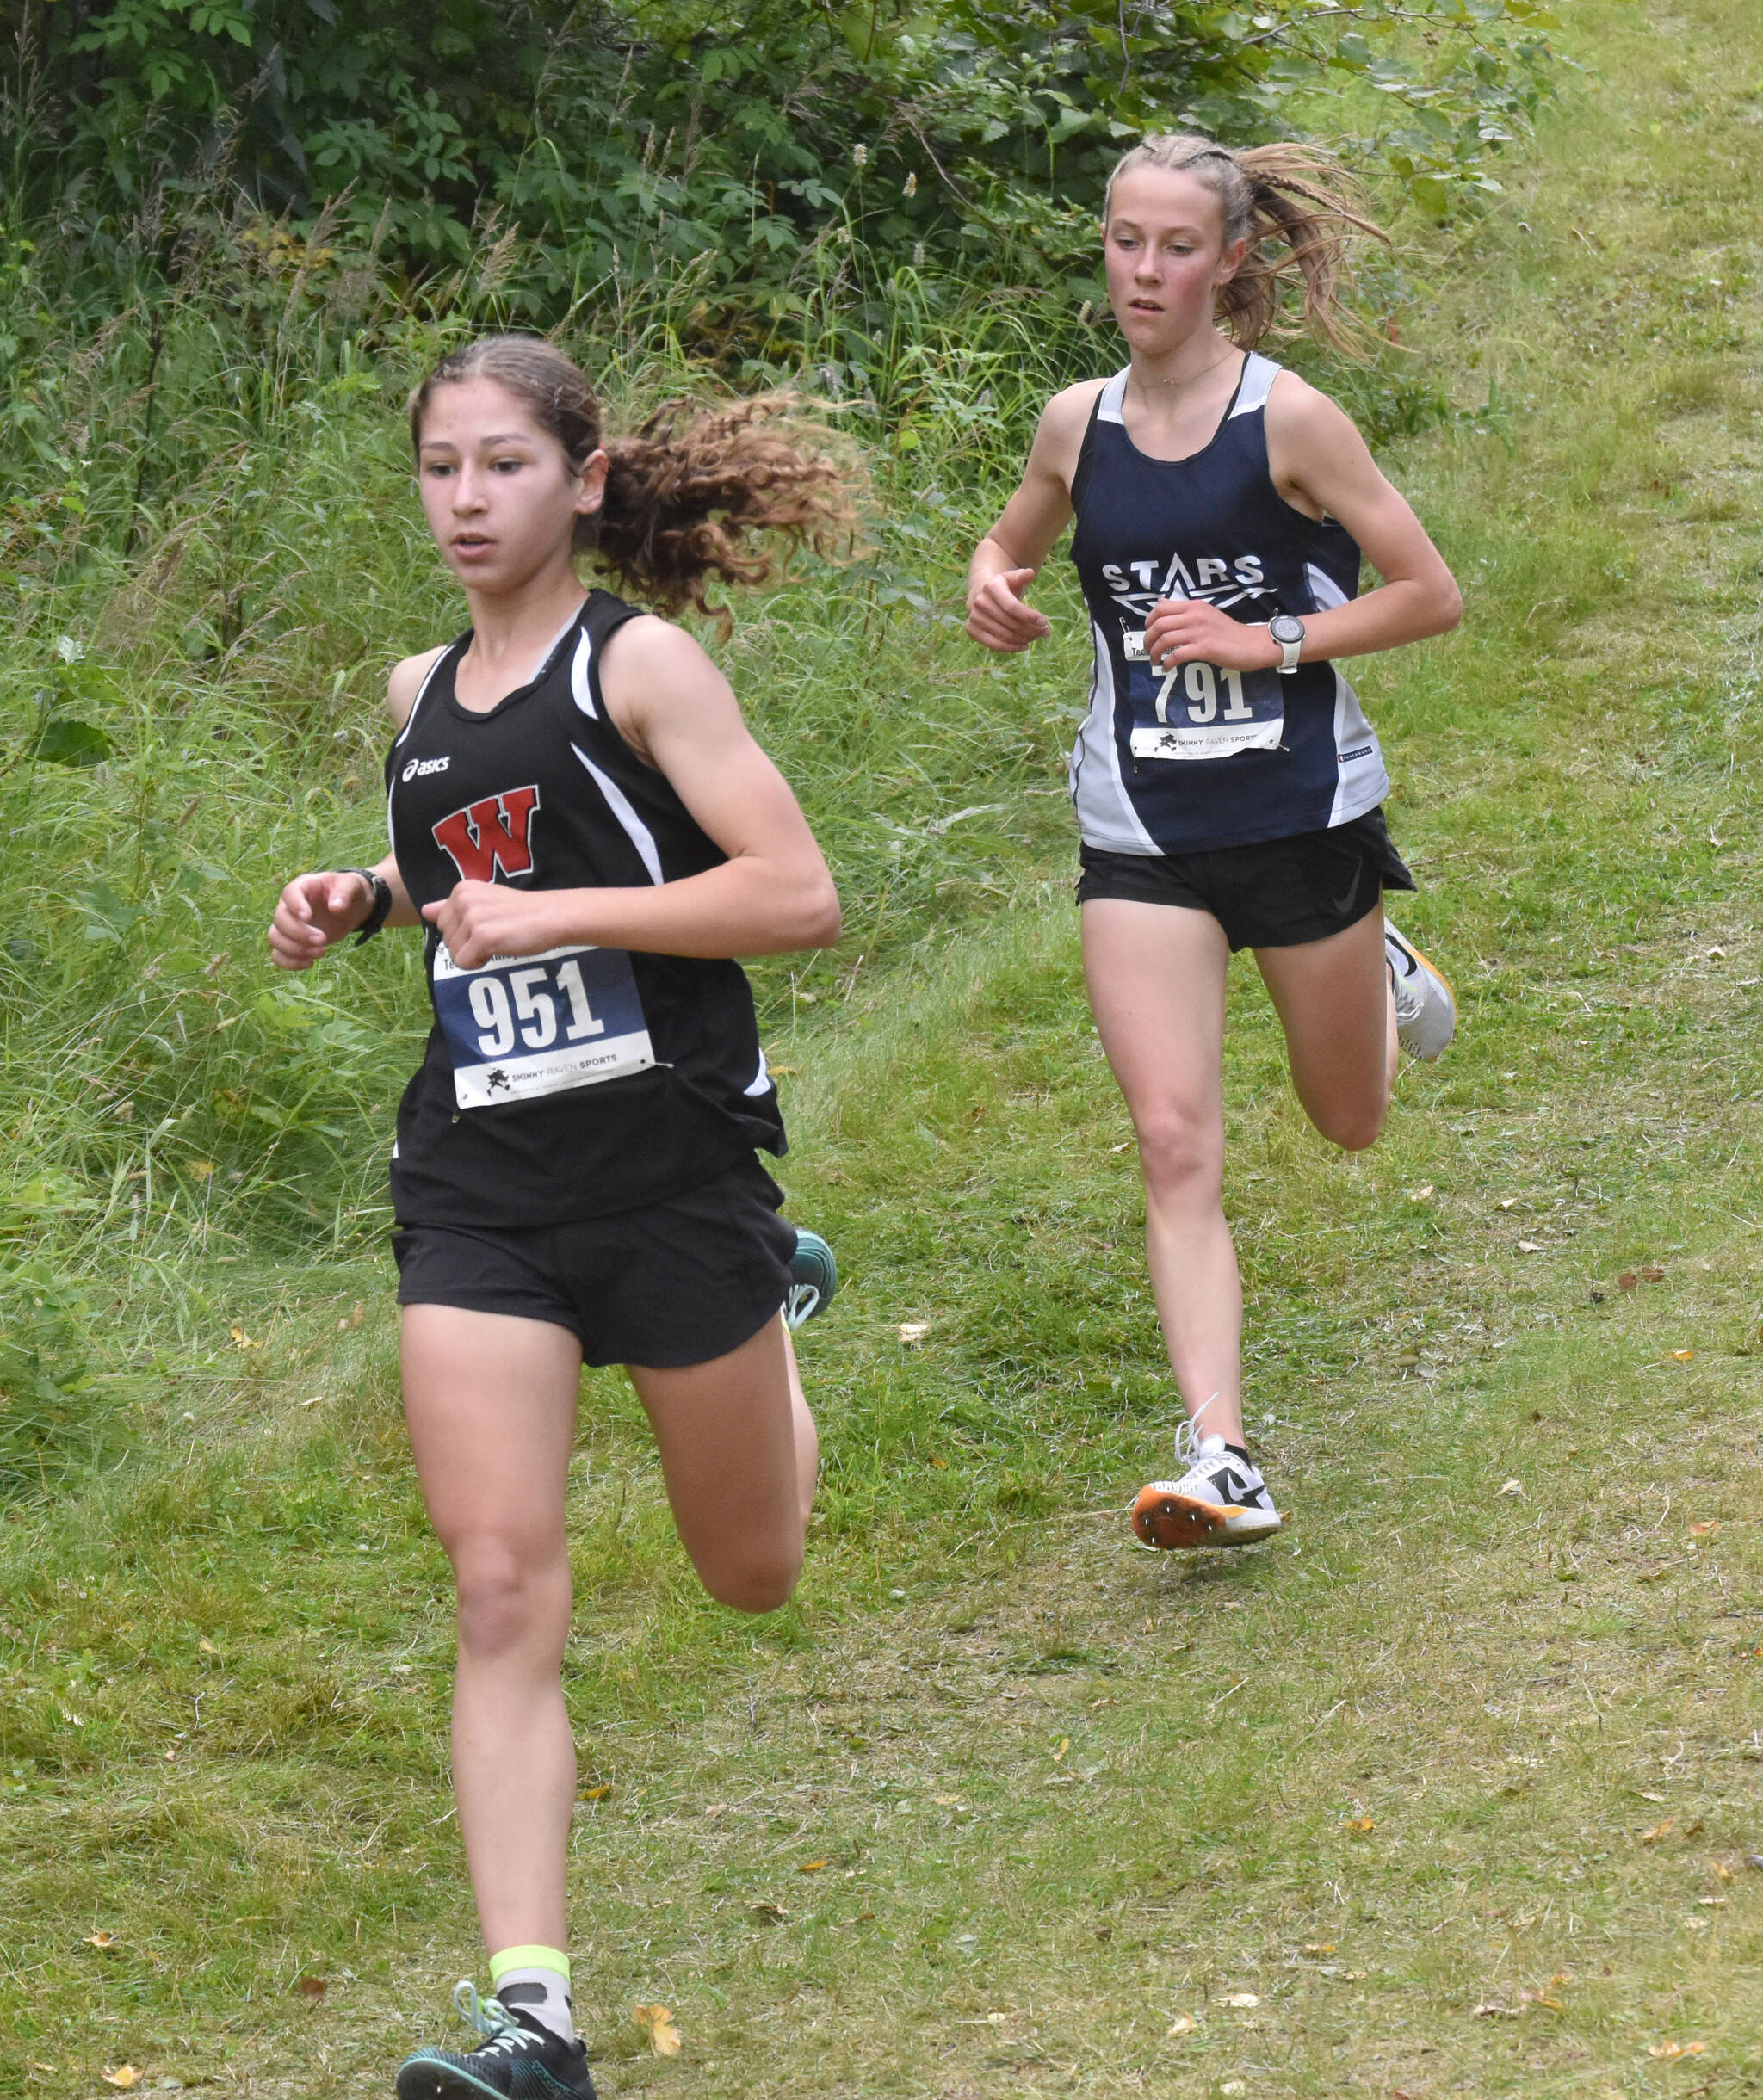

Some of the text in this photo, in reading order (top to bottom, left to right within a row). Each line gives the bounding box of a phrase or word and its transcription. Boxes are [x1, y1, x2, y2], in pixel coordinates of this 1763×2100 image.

[1102, 551, 1264, 592] STARS
[1151, 662, 1253, 723] 791
[432, 784, 541, 883] W
[468, 959, 605, 1057] 951
[511, 1053, 617, 1083] SKINNY RAVEN SPORTS
